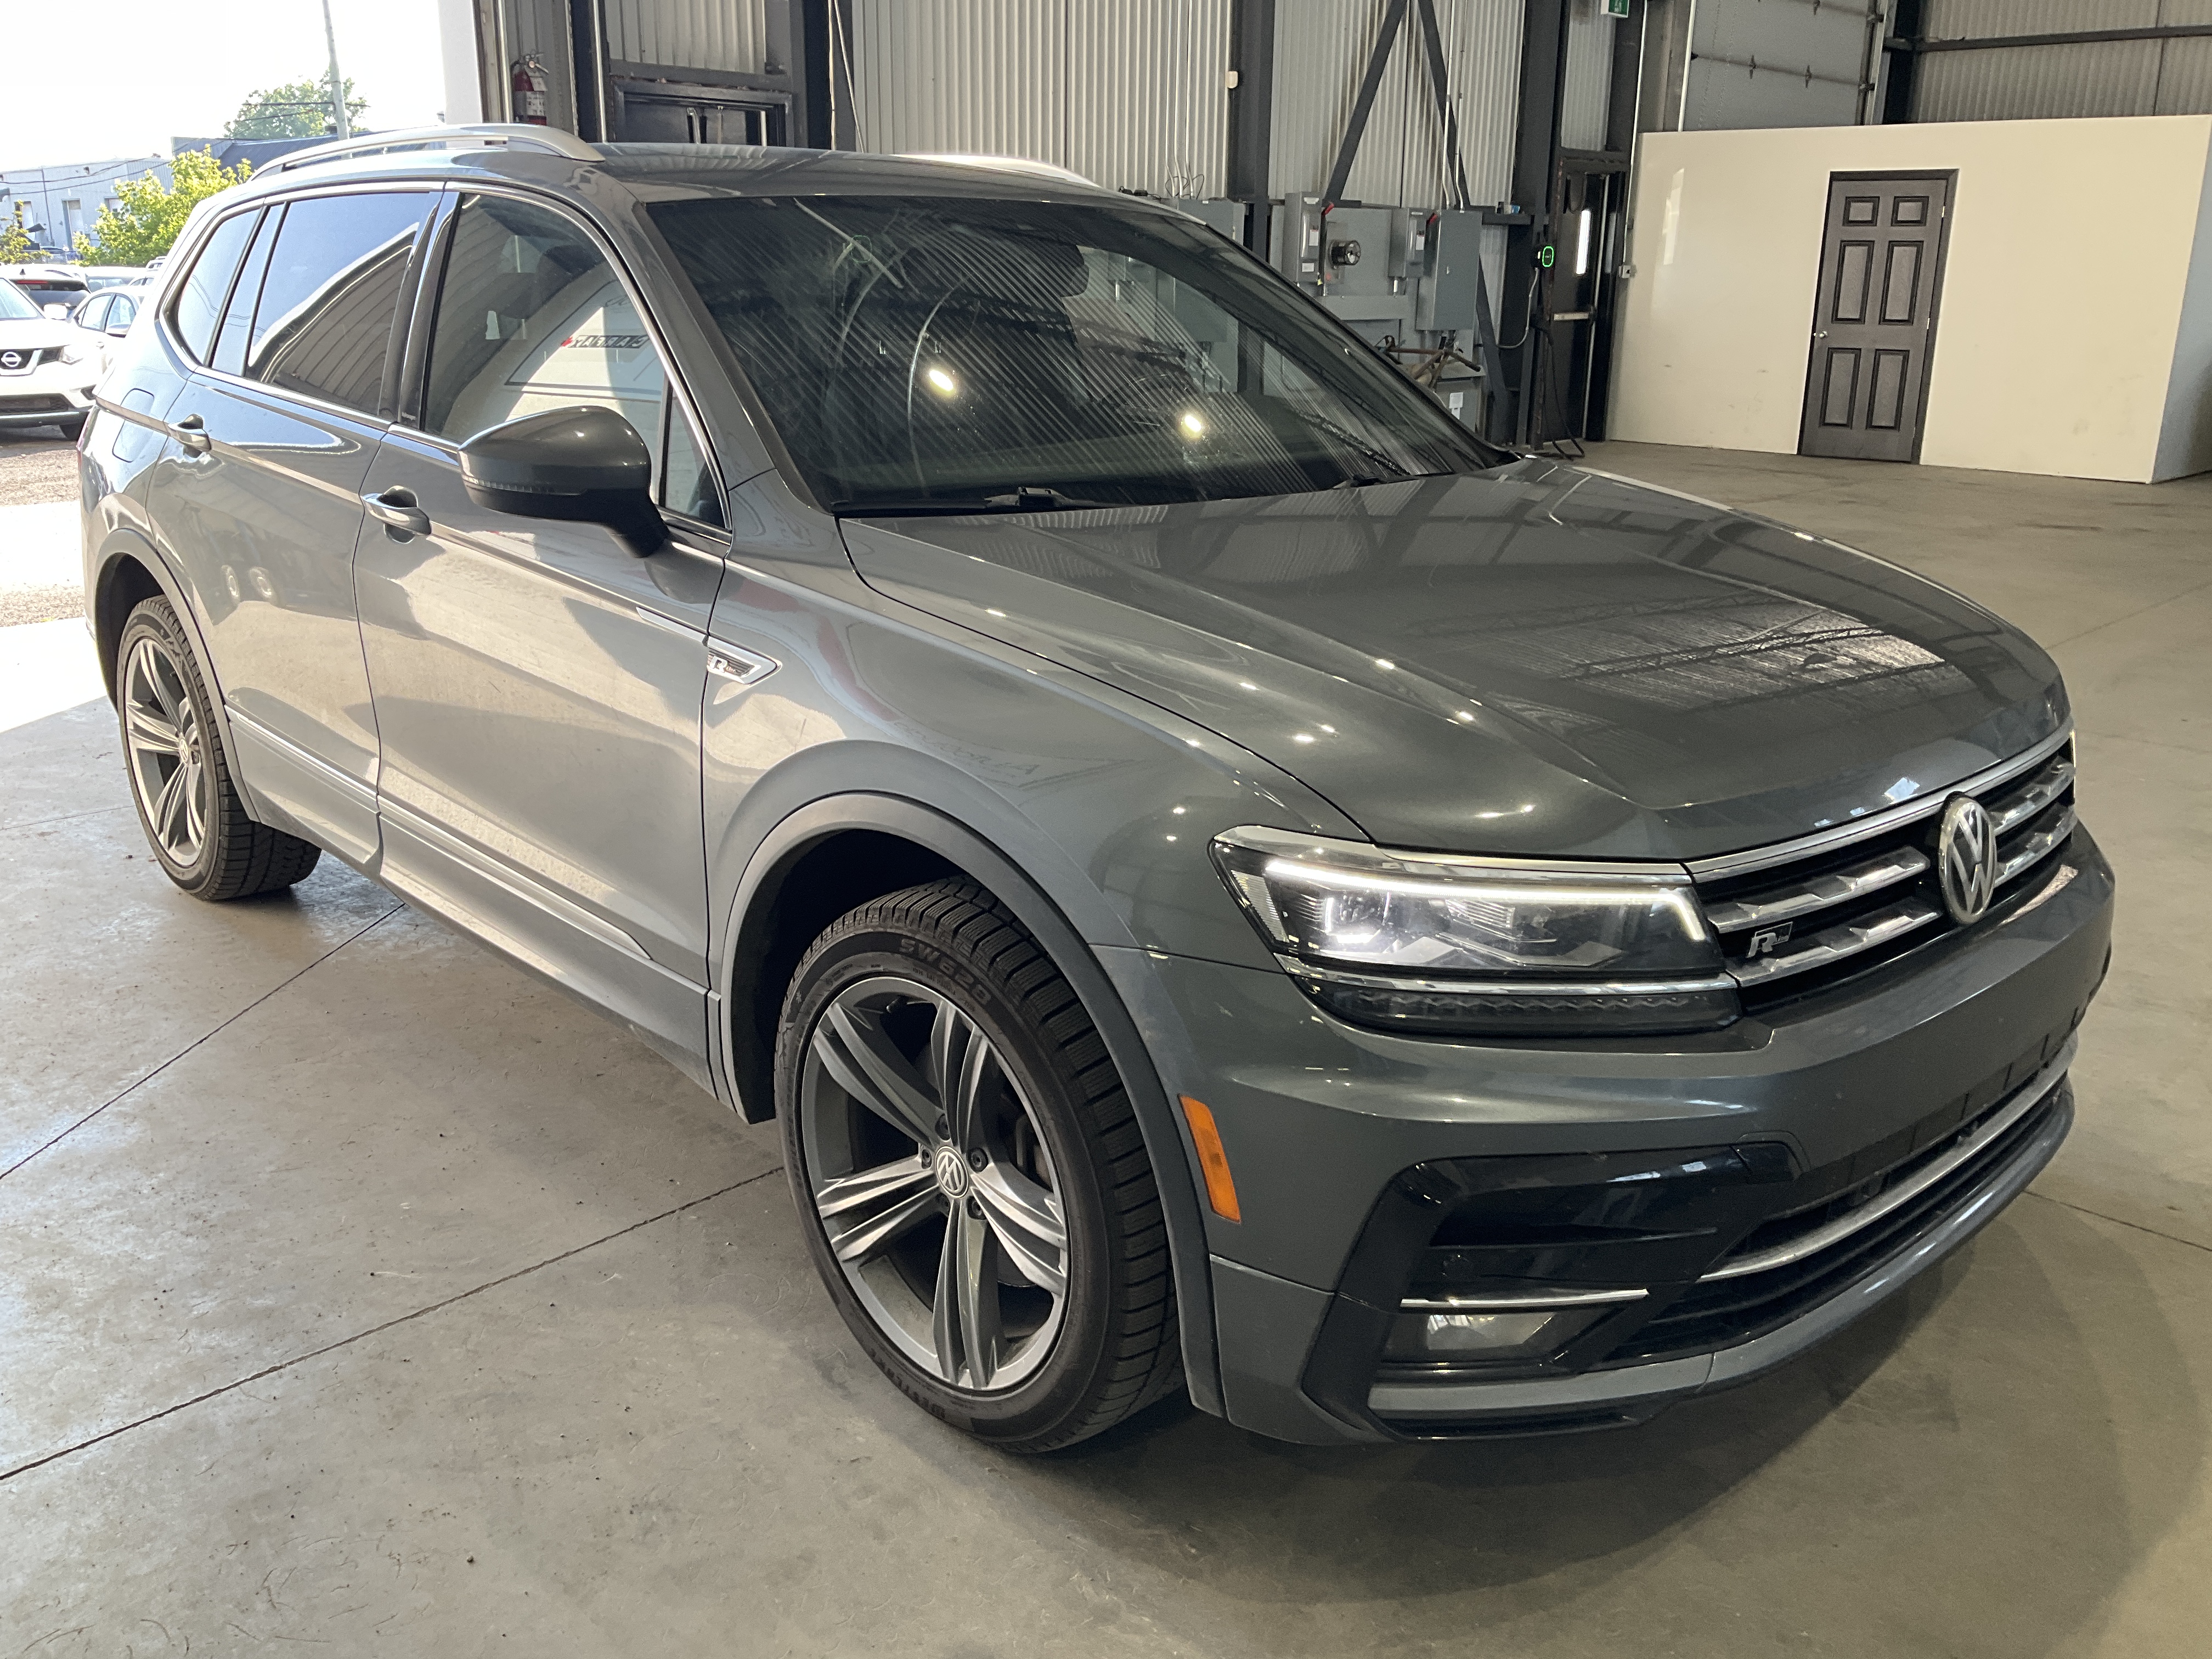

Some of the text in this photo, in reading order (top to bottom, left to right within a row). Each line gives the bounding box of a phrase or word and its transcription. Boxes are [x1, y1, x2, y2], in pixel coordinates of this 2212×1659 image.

[1943, 802, 1995, 917] VW
[900, 938, 991, 1005] SW628
[937, 1151, 965, 1194] VW
